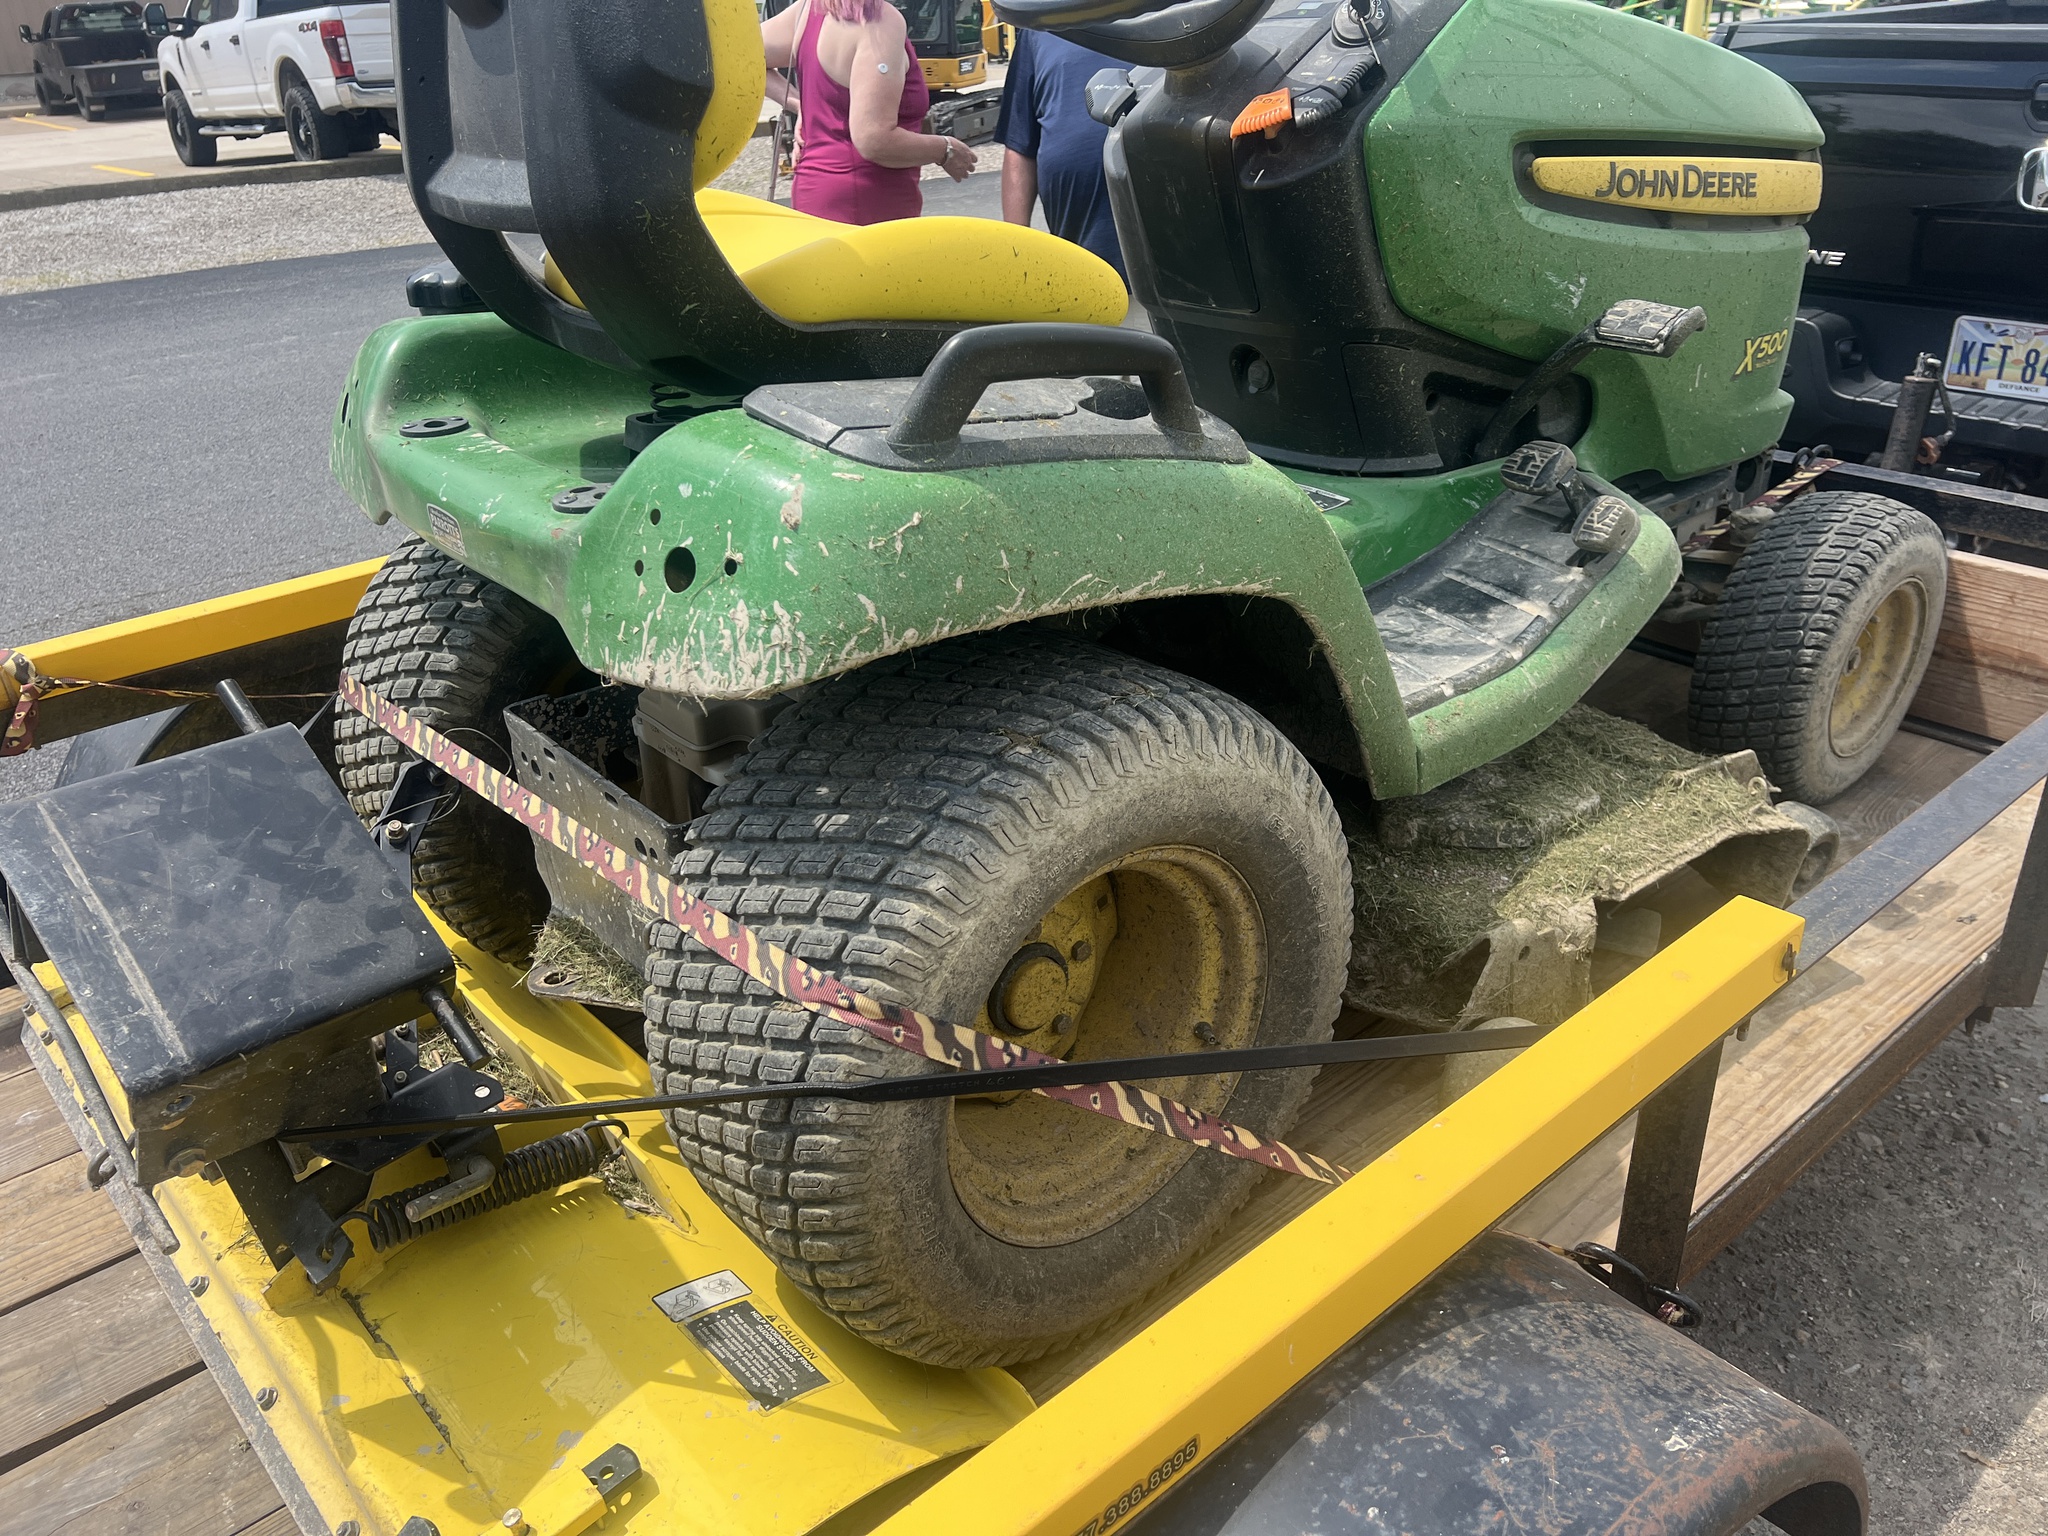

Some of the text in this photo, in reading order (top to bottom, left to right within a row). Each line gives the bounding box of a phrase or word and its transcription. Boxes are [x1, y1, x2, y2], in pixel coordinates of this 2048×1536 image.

[1595, 161, 1757, 199] JOHN DEERE
[1733, 328, 1788, 376] X500
[1956, 340, 2013, 380] KFT
[1998, 382, 2041, 393] DEFIANCE
[748, 1309, 767, 1324] HELP
[796, 1356, 816, 1373] FROM
[753, 1323, 797, 1363] SUDDEN STOPS
[775, 1322, 819, 1360] CAUTION
[1078, 1440, 1197, 1536] 7.388.8895
